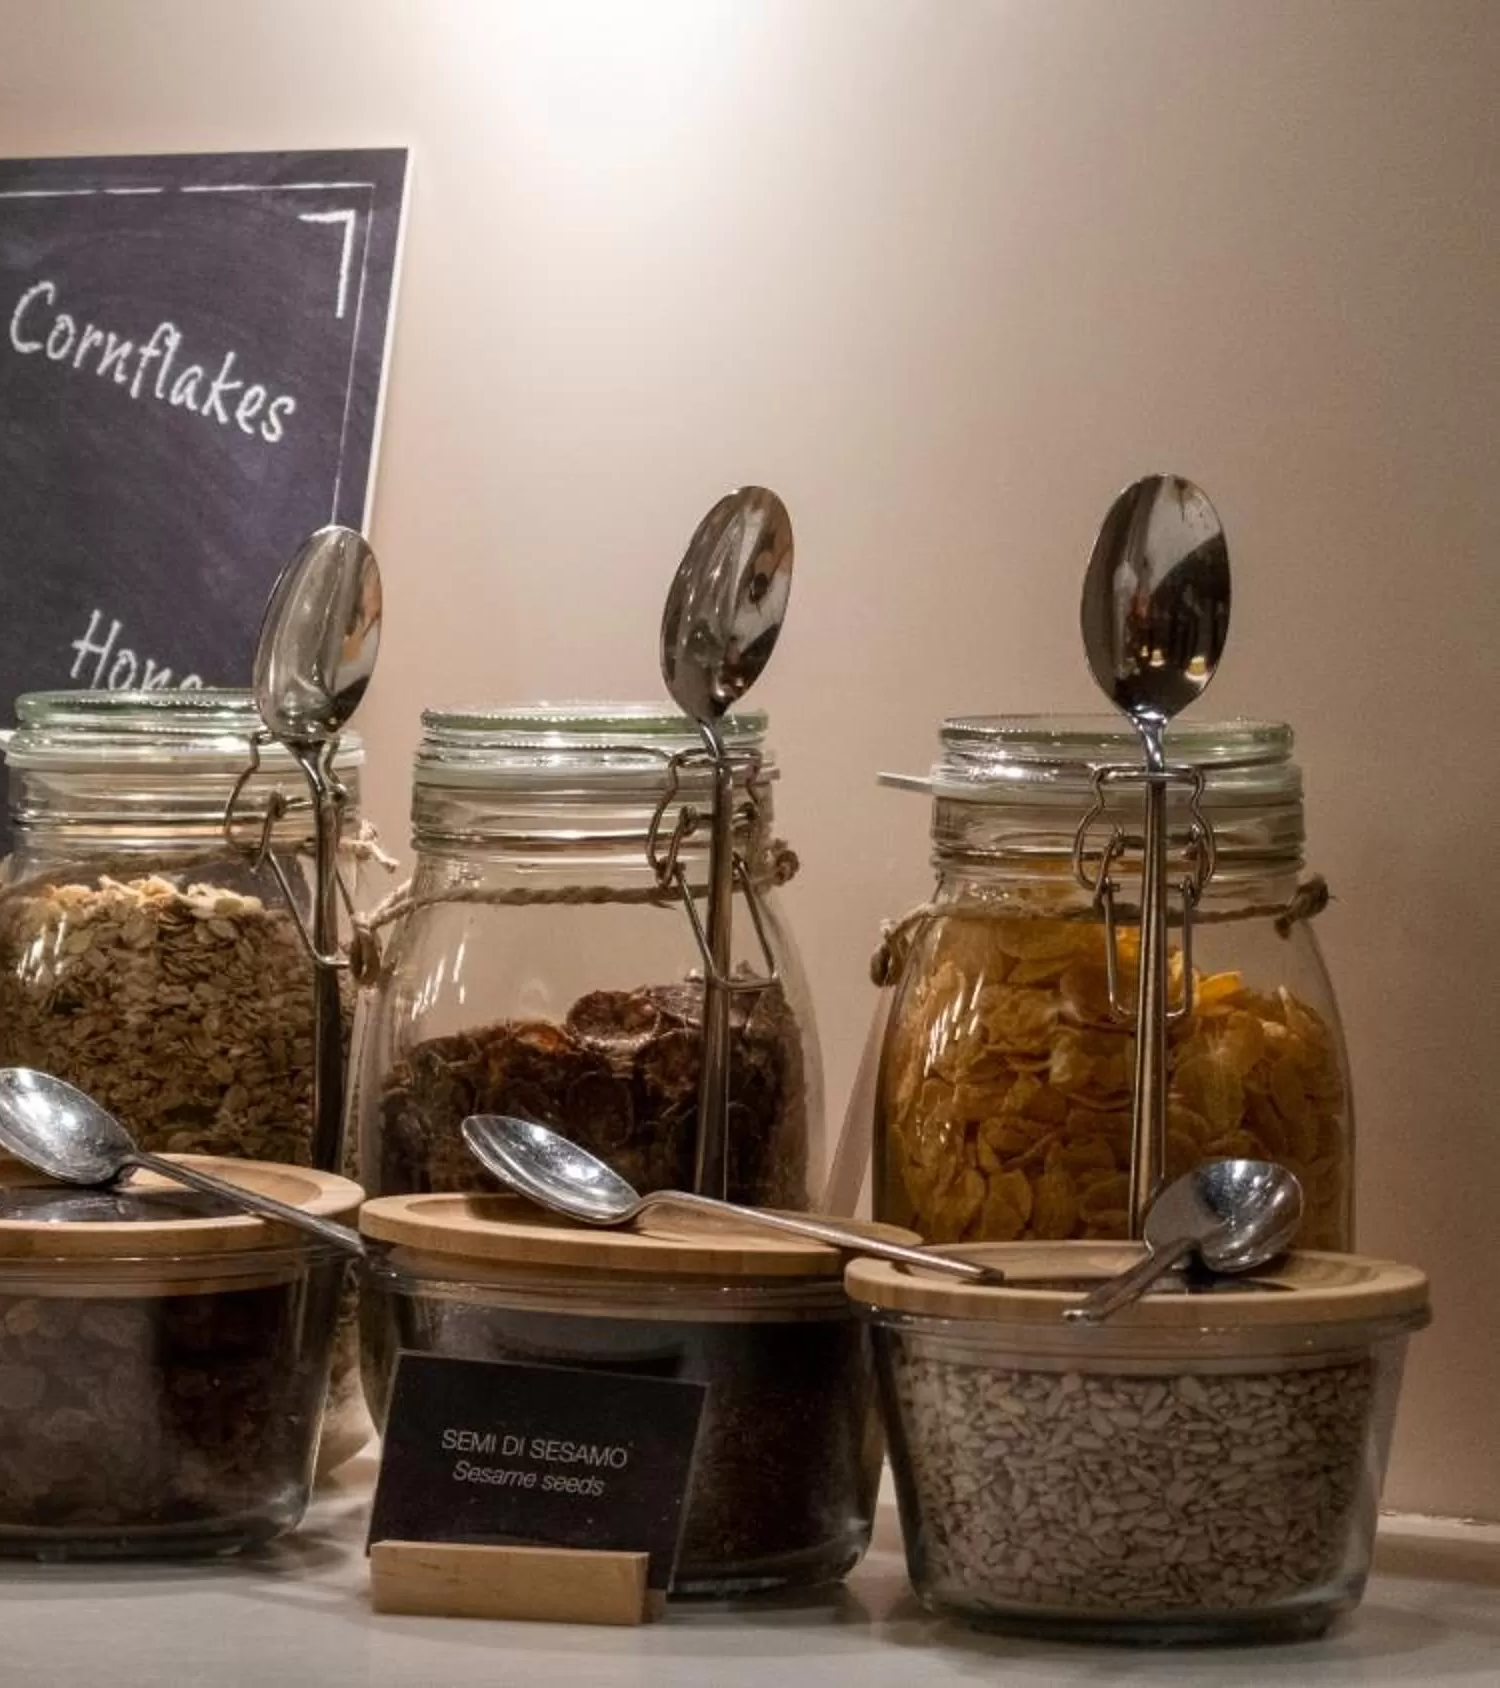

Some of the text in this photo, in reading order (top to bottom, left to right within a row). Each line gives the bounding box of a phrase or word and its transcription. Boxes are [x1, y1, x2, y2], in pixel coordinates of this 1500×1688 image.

[9, 278, 296, 443] Cornflakes
[441, 1429, 628, 1469] SEMI DI SESAMO
[452, 1460, 605, 1497] Sesame seeds
